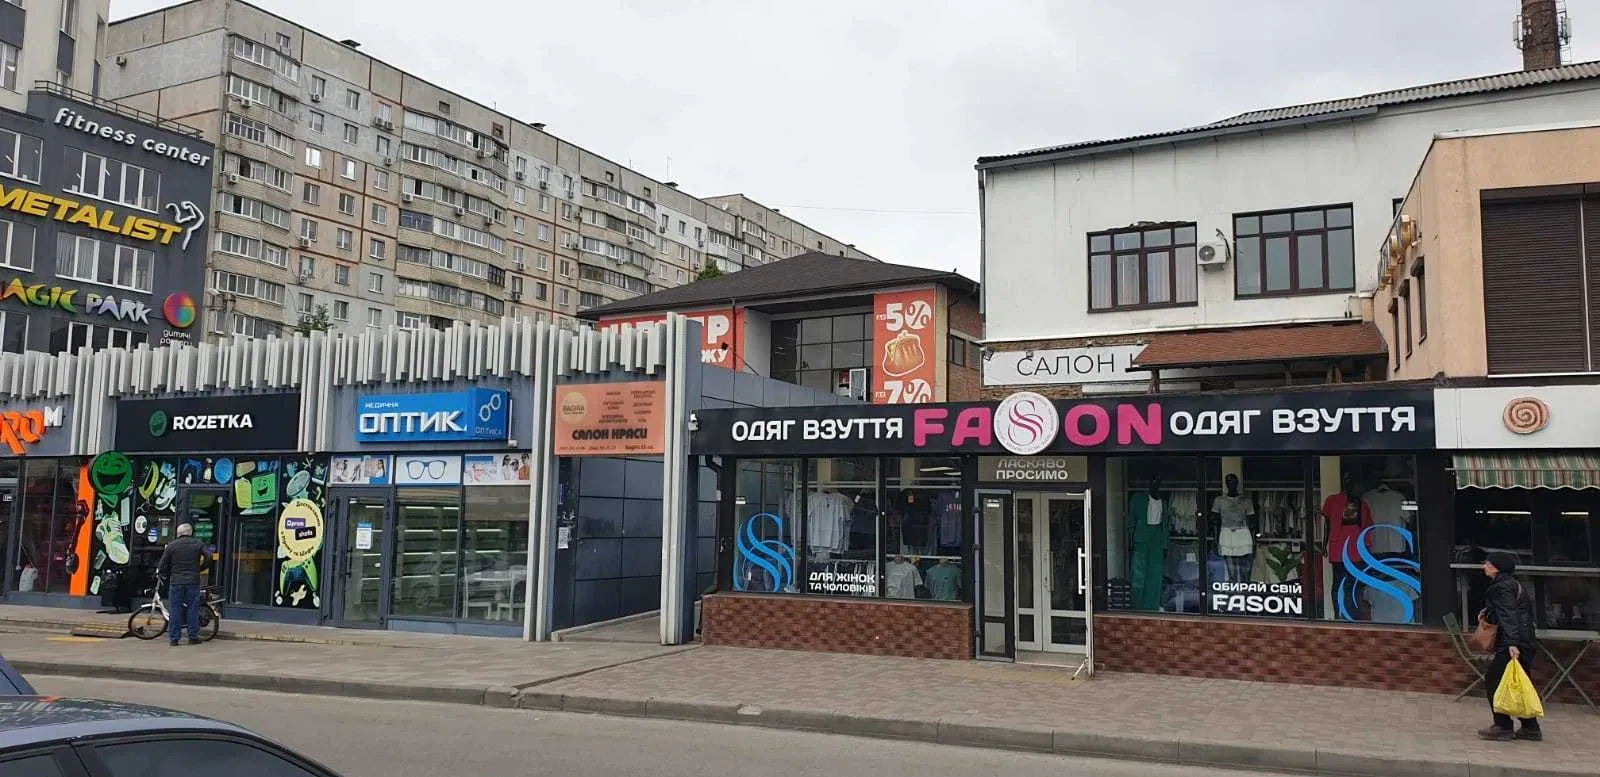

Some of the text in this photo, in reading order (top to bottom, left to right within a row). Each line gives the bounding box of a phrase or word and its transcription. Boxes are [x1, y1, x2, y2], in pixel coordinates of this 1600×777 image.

[54, 107, 211, 167] fitness center
[0, 184, 183, 245] METALIST
[0, 277, 152, 325] AGIC PARK
[1017, 353, 1114, 376] САЛОН
[172, 413, 253, 430] ROZETKA
[360, 410, 468, 433] ОПТИК
[732, 418, 903, 441] ОДЯГ ВЗУТТЯ
[1170, 406, 1416, 435] ОДЯГ ВЗУТТЯ
[998, 458, 1066, 469] ЛАСКАВО
[996, 469, 1069, 480] ПРОСИМО
[809, 572, 875, 583] ДЛЯ ЖІНОК
[809, 582, 876, 593] ТА ЧОЛОВІКІВ
[1212, 581, 1302, 593] ОБИРАЙ СВІЙ
[1212, 594, 1303, 614] FASON
